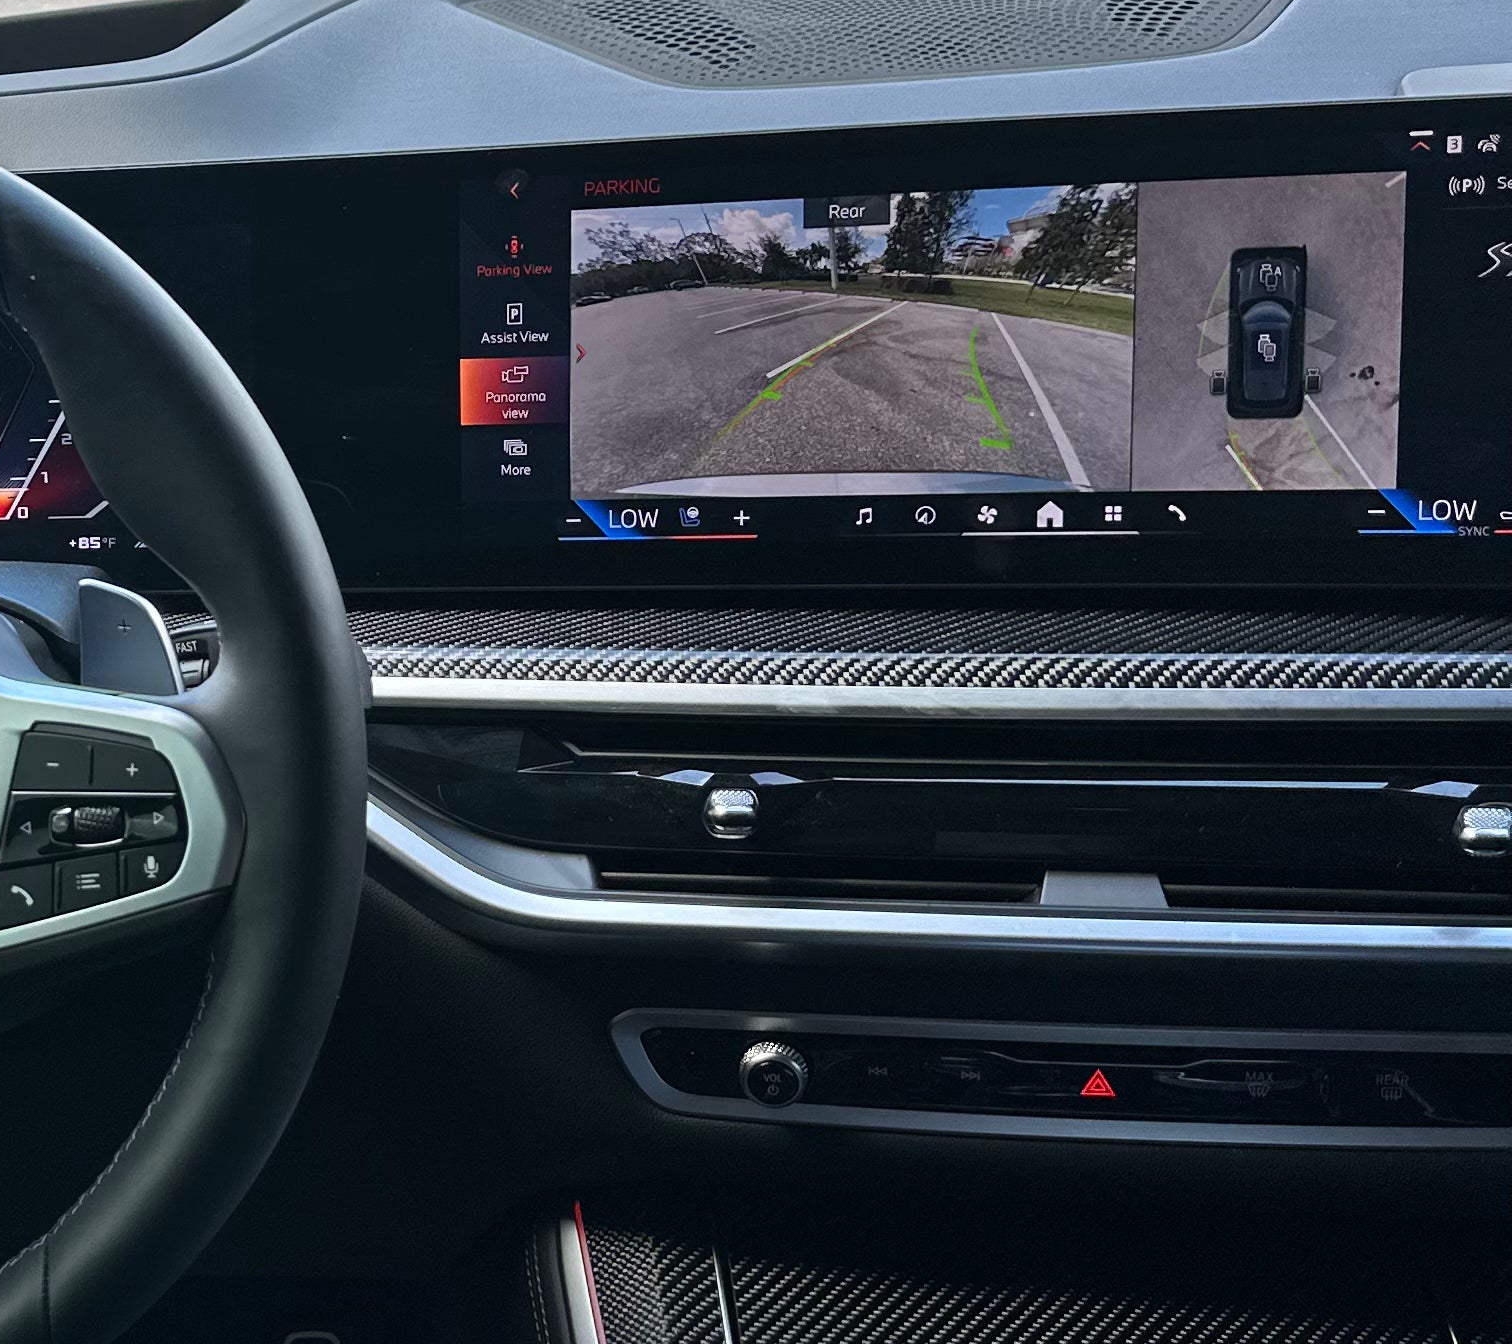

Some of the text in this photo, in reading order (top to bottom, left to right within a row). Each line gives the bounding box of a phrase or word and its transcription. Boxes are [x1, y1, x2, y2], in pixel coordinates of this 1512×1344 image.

[584, 178, 661, 196] PARKING
[828, 204, 866, 219] Rear
[476, 264, 553, 278] Parking View
[481, 331, 550, 344] Assist View
[486, 391, 547, 404] Panorama
[501, 407, 529, 420] view
[61, 433, 73, 445] 2
[501, 464, 531, 476] More
[40, 472, 49, 484] 1
[17, 506, 28, 519] 0
[1418, 499, 1477, 521] LOW
[609, 508, 659, 528] LOW
[1457, 525, 1490, 537] SYNC
[175, 640, 198, 653] FAST
[762, 1073, 783, 1083] VOL
[1245, 1071, 1274, 1083] MAX
[1376, 1073, 1409, 1086] REAR
